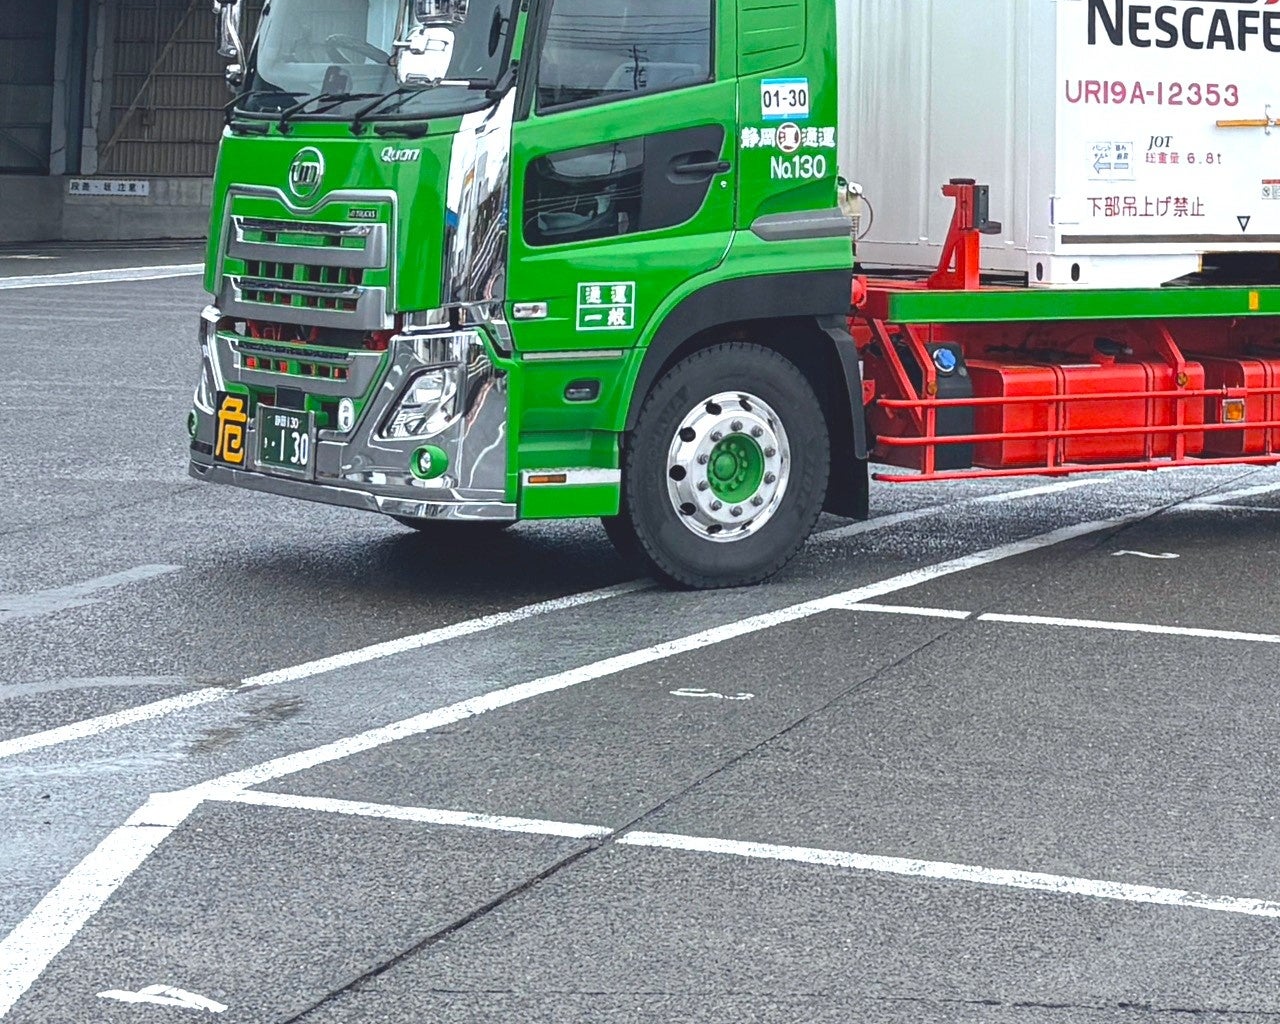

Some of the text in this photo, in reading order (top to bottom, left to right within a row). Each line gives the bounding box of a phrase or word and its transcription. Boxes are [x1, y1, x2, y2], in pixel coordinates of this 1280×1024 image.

[763, 89, 807, 108] 01-30
[1147, 136, 1174, 151] JOT
[1087, 196, 1206, 218] 下部吊上げ禁止
[584, 308, 627, 326] 一般
[215, 395, 248, 464] 危
